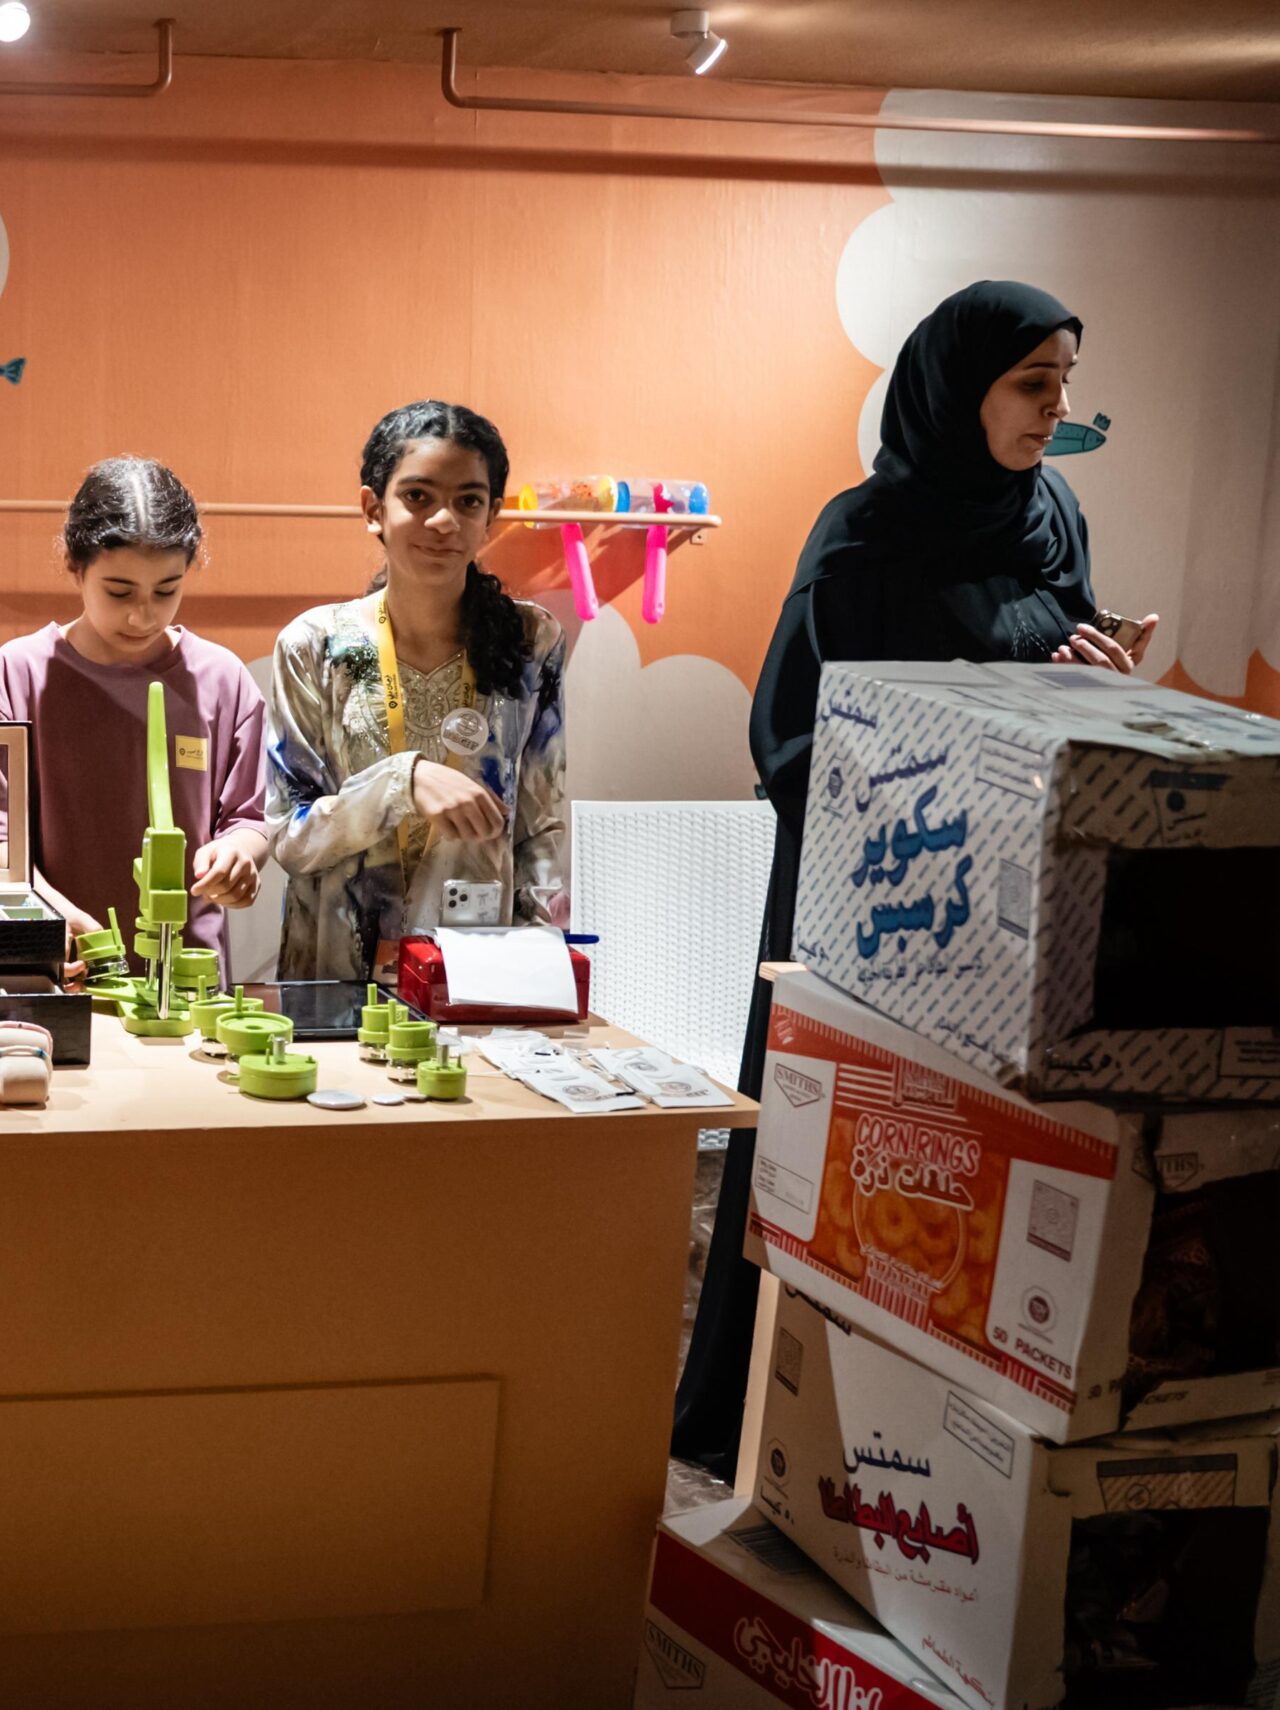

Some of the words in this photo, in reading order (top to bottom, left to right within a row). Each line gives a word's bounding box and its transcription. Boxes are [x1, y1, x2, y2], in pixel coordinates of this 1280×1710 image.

[850, 785, 968, 888] سكوير
[855, 854, 973, 959] كرسبس
[775, 1067, 821, 1097] SMITHS
[856, 1113, 915, 1157] CORN
[914, 1126, 982, 1177] RINGS
[992, 1326, 1009, 1346] 50
[1014, 1336, 1073, 1380] PACKETS
[843, 1430, 932, 1478] سمتس
[646, 1623, 704, 1678] SMITHS
